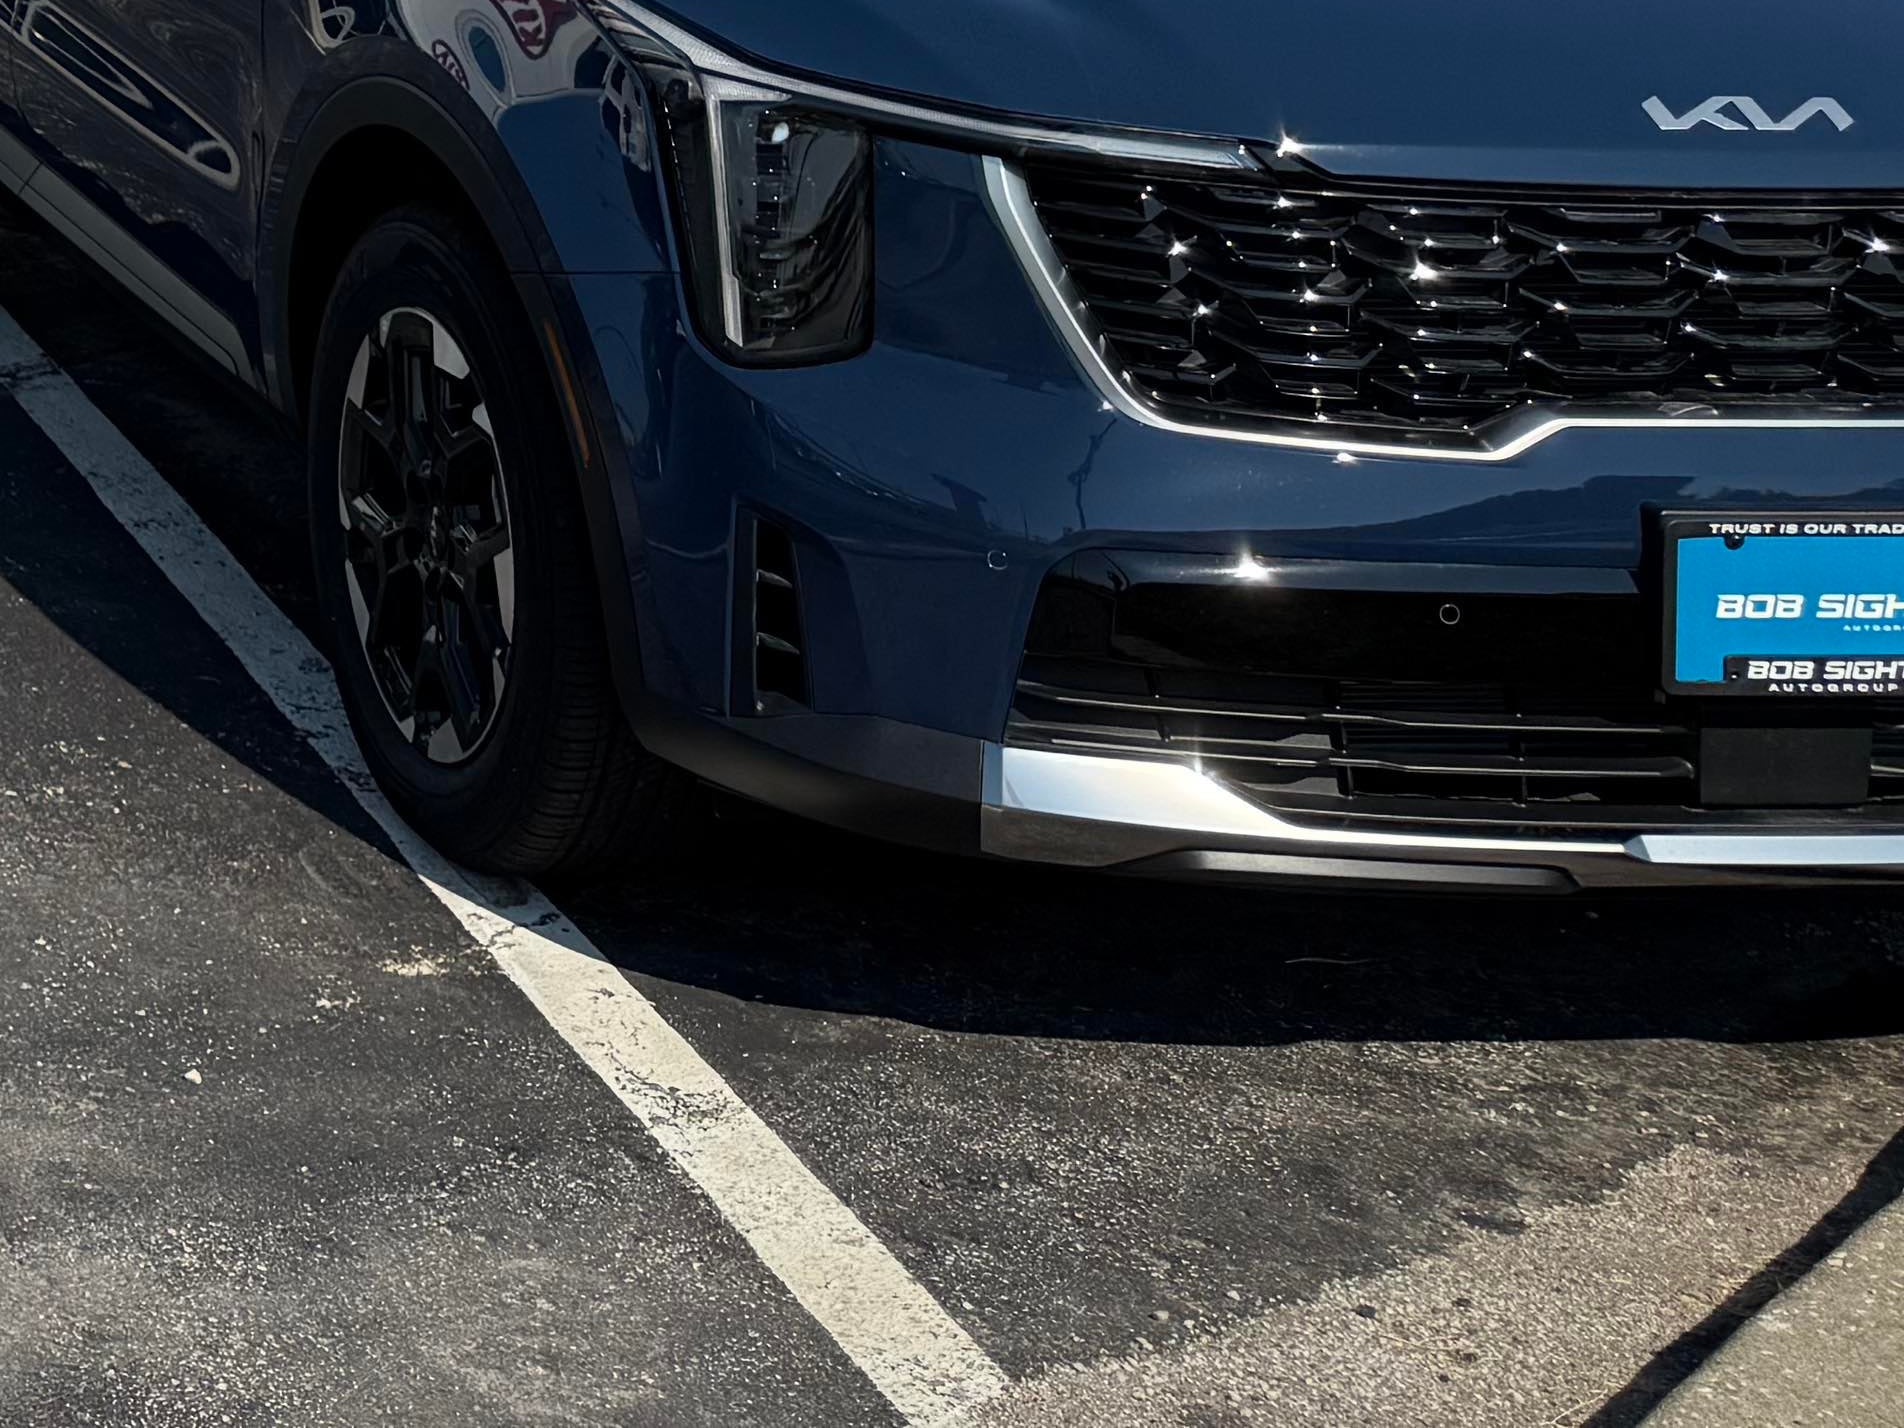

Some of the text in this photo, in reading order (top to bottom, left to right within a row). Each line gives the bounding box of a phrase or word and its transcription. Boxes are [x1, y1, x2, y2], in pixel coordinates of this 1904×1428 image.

[1708, 523, 1777, 535] TRUST
[1779, 523, 1799, 535] IS
[1803, 523, 1847, 535] OUR
[1715, 594, 1805, 619] BOB
[1843, 624, 1904, 632] AUTOGR
[1747, 660, 1815, 680] BOB
[1768, 683, 1899, 693] AUTOGROUP
